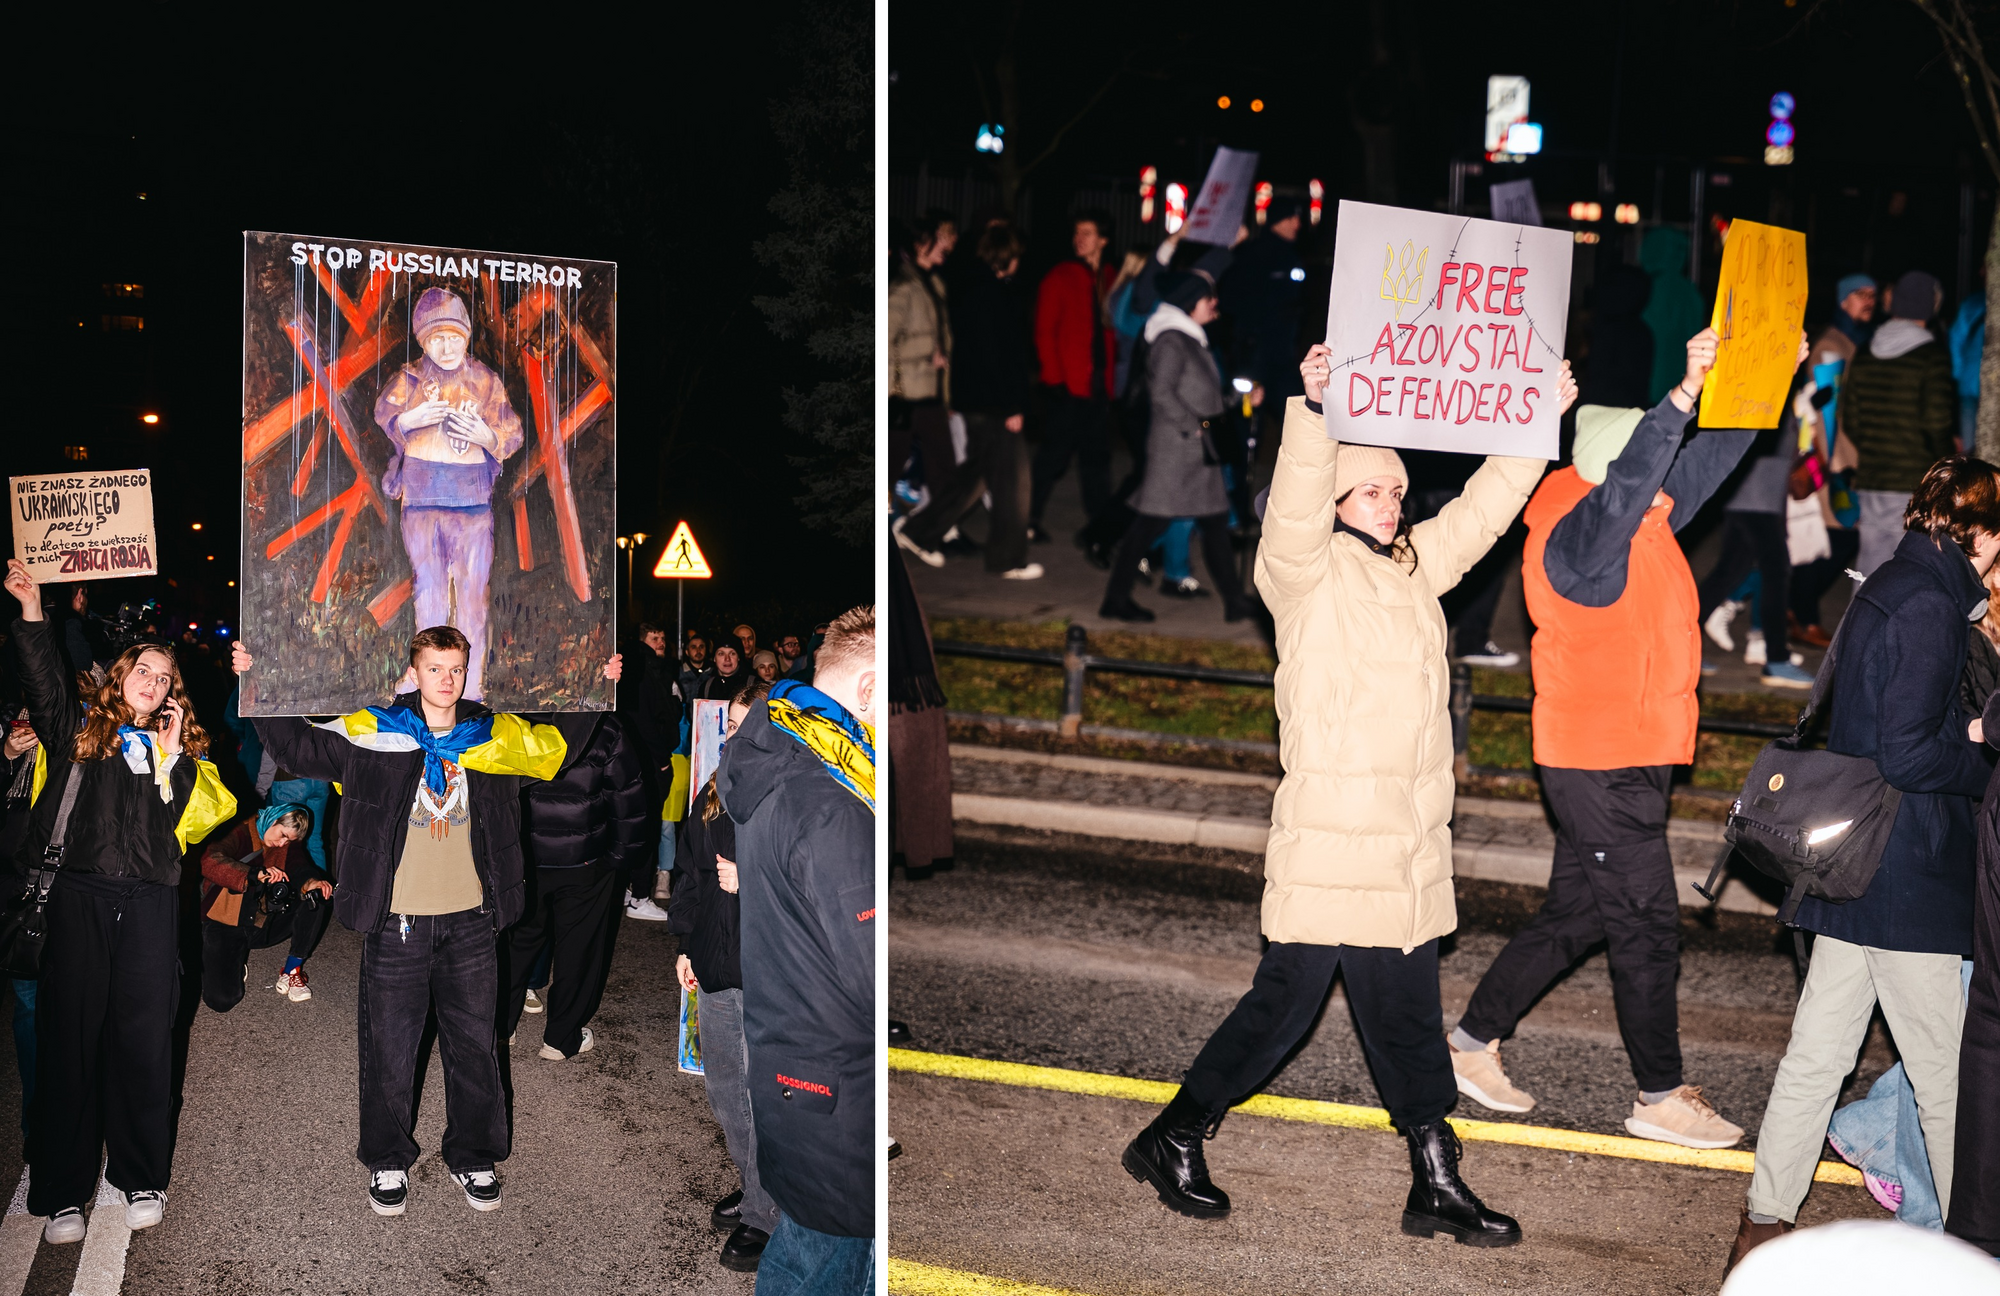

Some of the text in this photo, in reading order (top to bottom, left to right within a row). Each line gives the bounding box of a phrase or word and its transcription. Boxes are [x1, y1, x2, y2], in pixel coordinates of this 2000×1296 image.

[291, 242, 582, 288] STOP RUSSIAN TERROR
[1735, 233, 1750, 286] 10
[1436, 262, 1528, 316] FREE
[1370, 322, 1543, 373] AZOVSTAL
[1348, 372, 1540, 425] DEFENDERS
[17, 475, 148, 494] NIE ZNASZ ŻADNEGO
[19, 490, 120, 521] UKRAIŃSKIEGO
[44, 514, 107, 539] poety?
[24, 533, 148, 554] to dlatego że większość
[26, 556, 36, 565] z
[37, 552, 62, 564] nich
[110, 544, 152, 570] ROSJA
[776, 1073, 833, 1097] ROSSIGNOL
